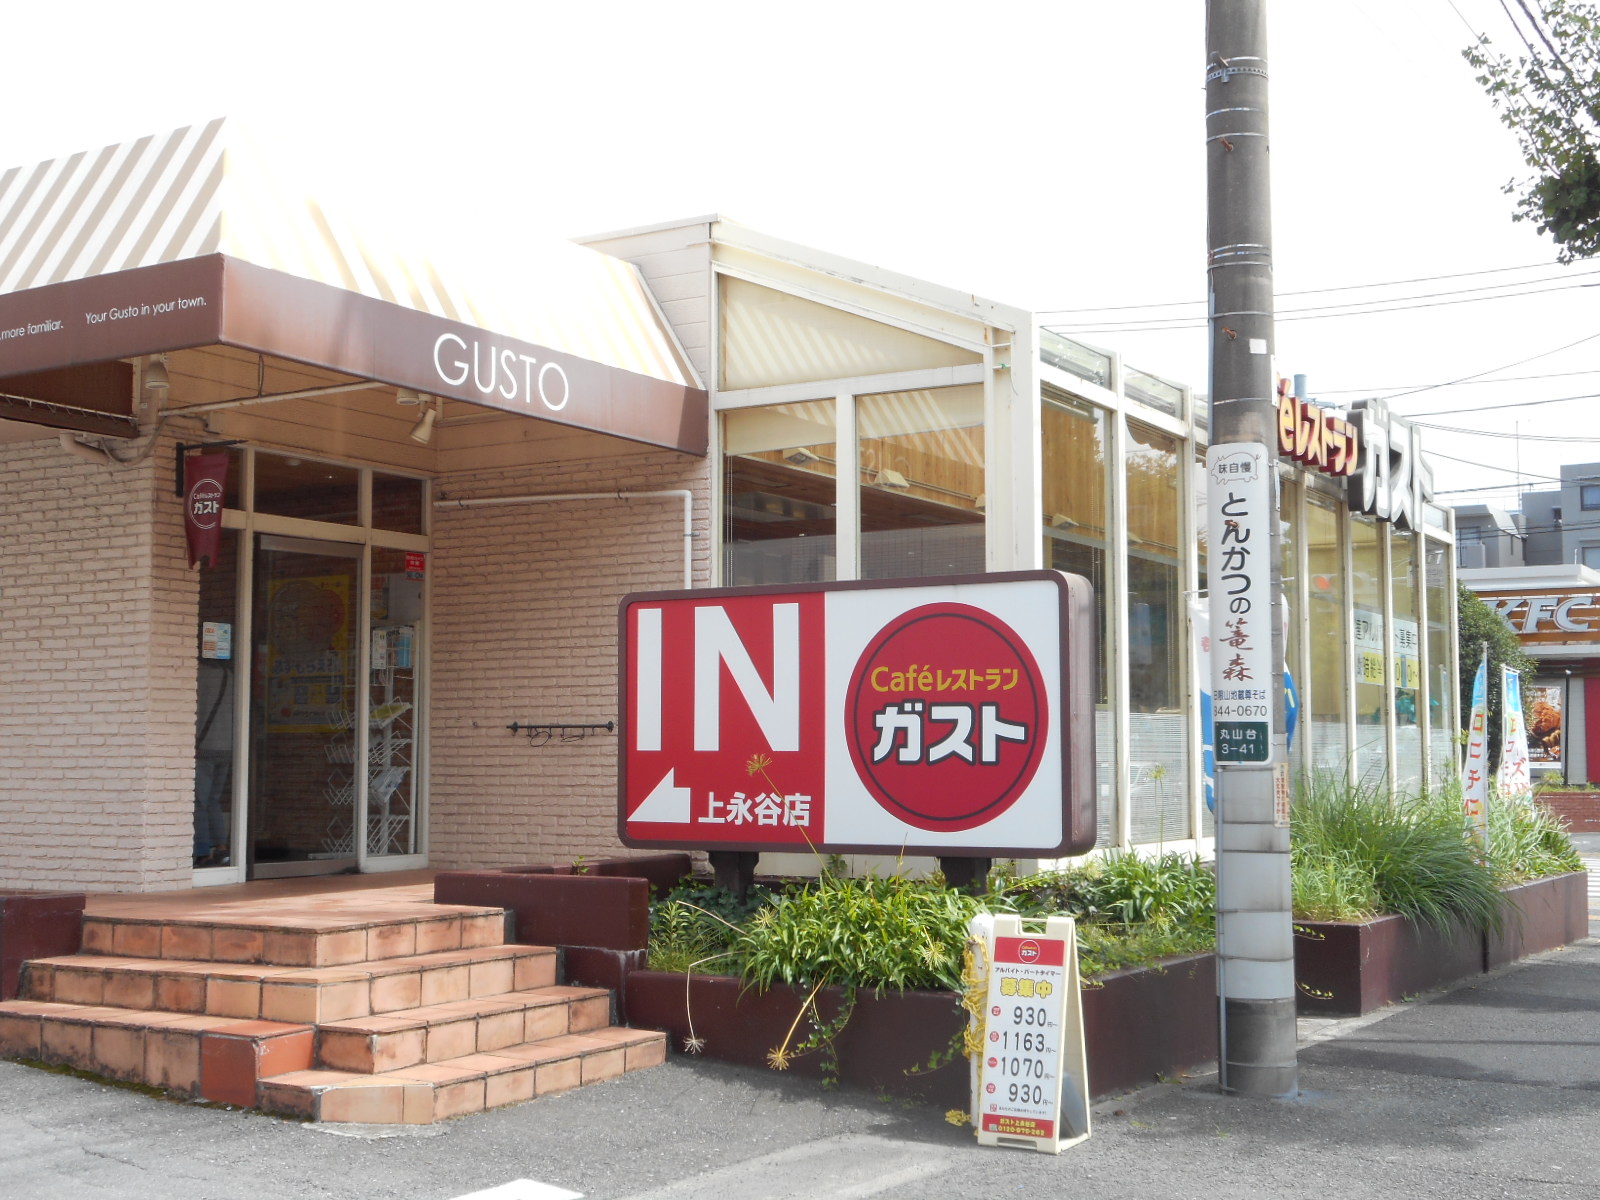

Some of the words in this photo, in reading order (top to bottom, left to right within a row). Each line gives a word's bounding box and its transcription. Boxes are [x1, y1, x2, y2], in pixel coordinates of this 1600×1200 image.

[85, 311, 108, 324] Your
[109, 305, 139, 321] Gusto
[141, 303, 150, 316] in
[152, 299, 175, 316] your
[178, 295, 207, 310] town.
[27, 319, 64, 335] familiar.
[433, 332, 570, 411] GUSTO
[1218, 461, 1252, 474] 味自慢
[1354, 398, 1434, 531] ガスト
[193, 500, 220, 515] ガスト
[1484, 597, 1593, 632] KFC
[636, 602, 799, 752] IN
[872, 698, 1029, 766] ガスト
[1219, 728, 1257, 740] 丸山台
[1221, 743, 1255, 754] 3-41
[697, 790, 812, 828] 上永谷店
[1021, 949, 1038, 957] ガスト
[1000, 976, 1053, 999] 募集中
[1013, 1005, 1047, 1027] 930
[1003, 1030, 1045, 1053] 1163
[1001, 1056, 1044, 1079] 1070
[1008, 1082, 1043, 1105] 930
